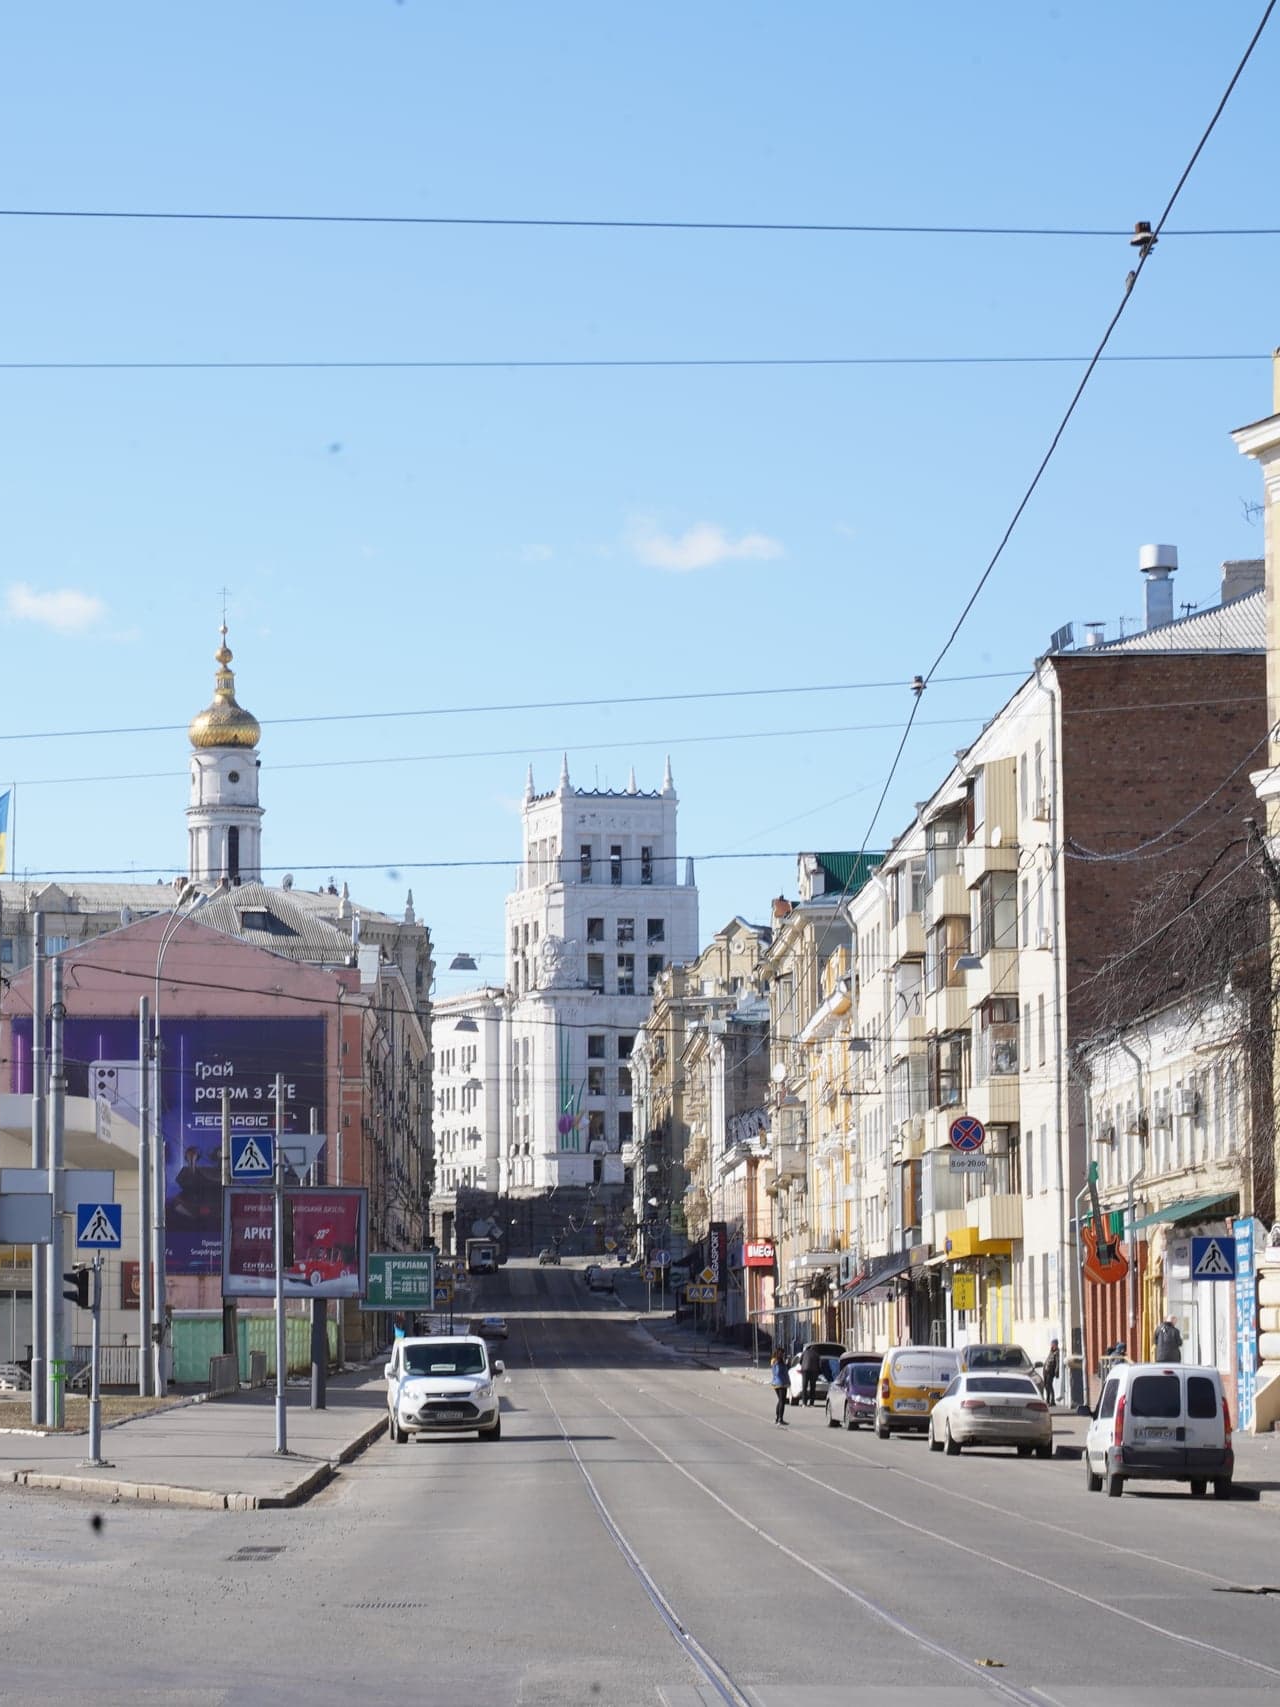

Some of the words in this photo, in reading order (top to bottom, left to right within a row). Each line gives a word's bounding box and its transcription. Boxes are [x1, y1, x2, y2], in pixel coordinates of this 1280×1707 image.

[195, 1061, 234, 1080] Грай
[253, 1087, 263, 1099] з
[243, 1227, 273, 1240] АРКТ
[393, 1261, 428, 1269] РЕКЛАМА
